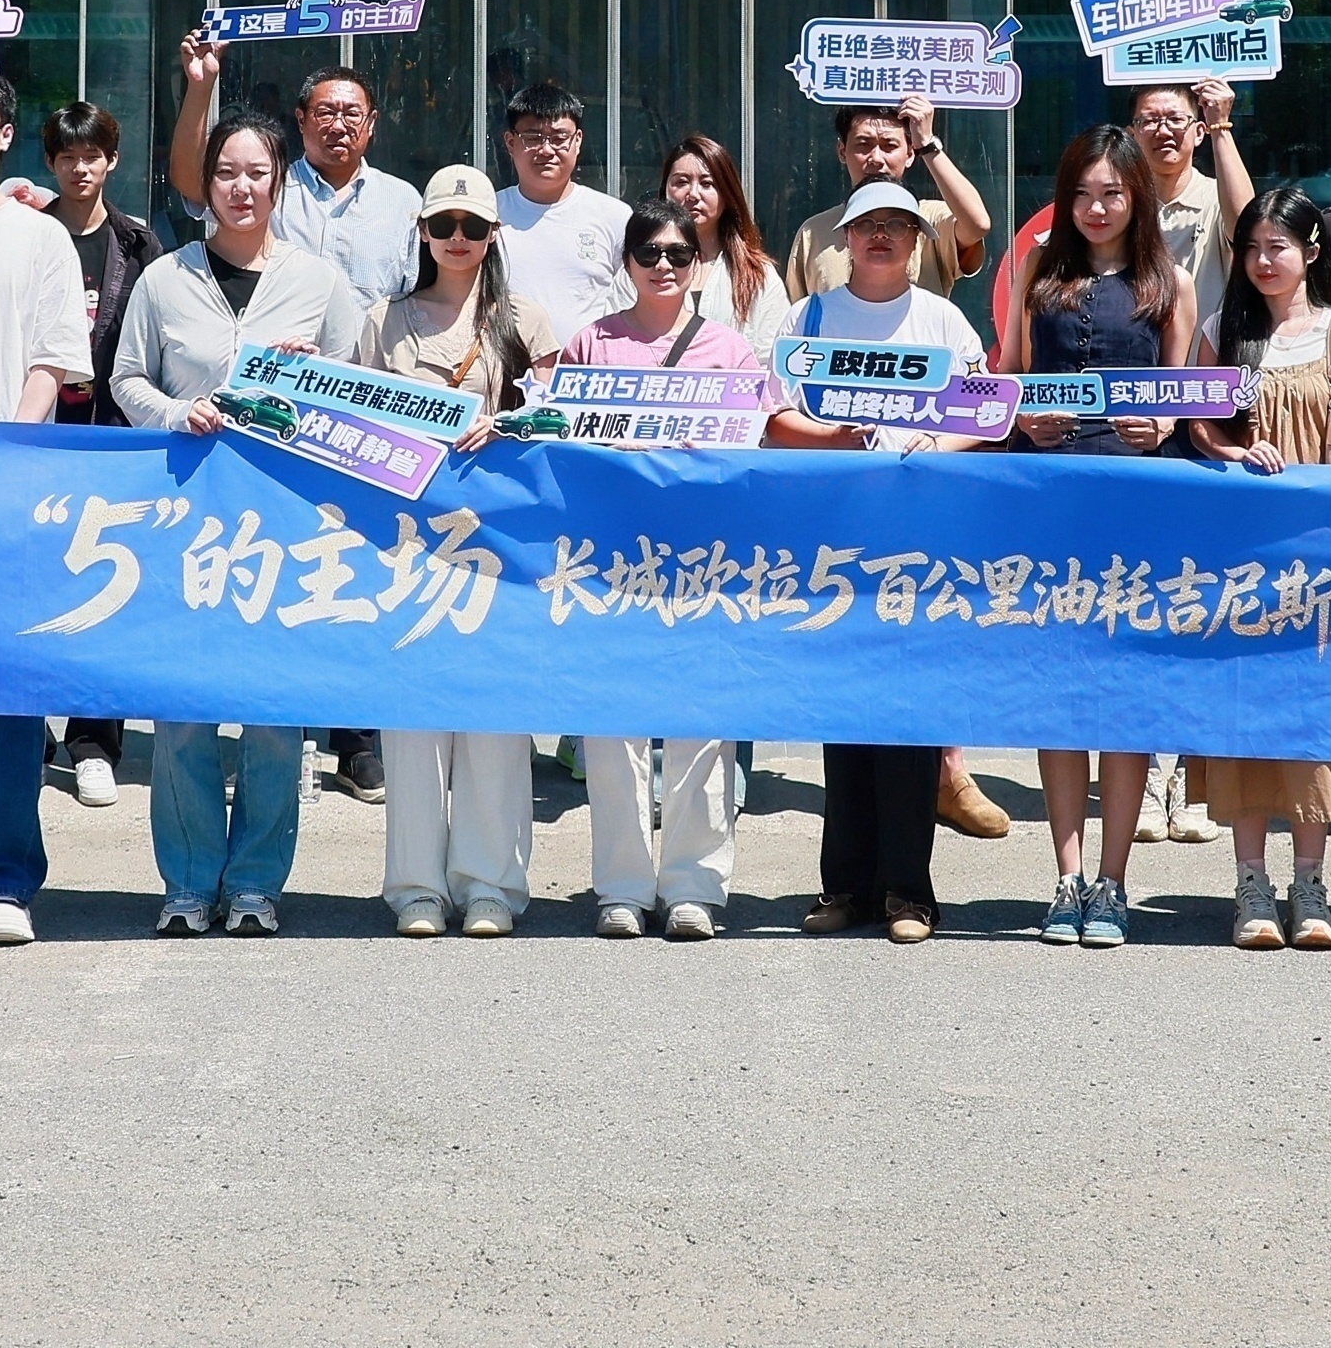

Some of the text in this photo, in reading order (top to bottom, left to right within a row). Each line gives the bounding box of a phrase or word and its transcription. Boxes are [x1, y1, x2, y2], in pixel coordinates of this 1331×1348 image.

[818, 33, 975, 63] 拒绝参数美颜
[1127, 28, 1268, 66] 全程不断点
[823, 65, 1006, 96] 真油耗全民实测
[453, 179, 468, 195] A
[828, 349, 929, 380] 欧拉5
[556, 372, 727, 403] 欧拉5混动版
[1109, 380, 1230, 405] 实测见真章
[819, 388, 1008, 428] 始终快人一步
[299, 409, 423, 479] 快顺静省
